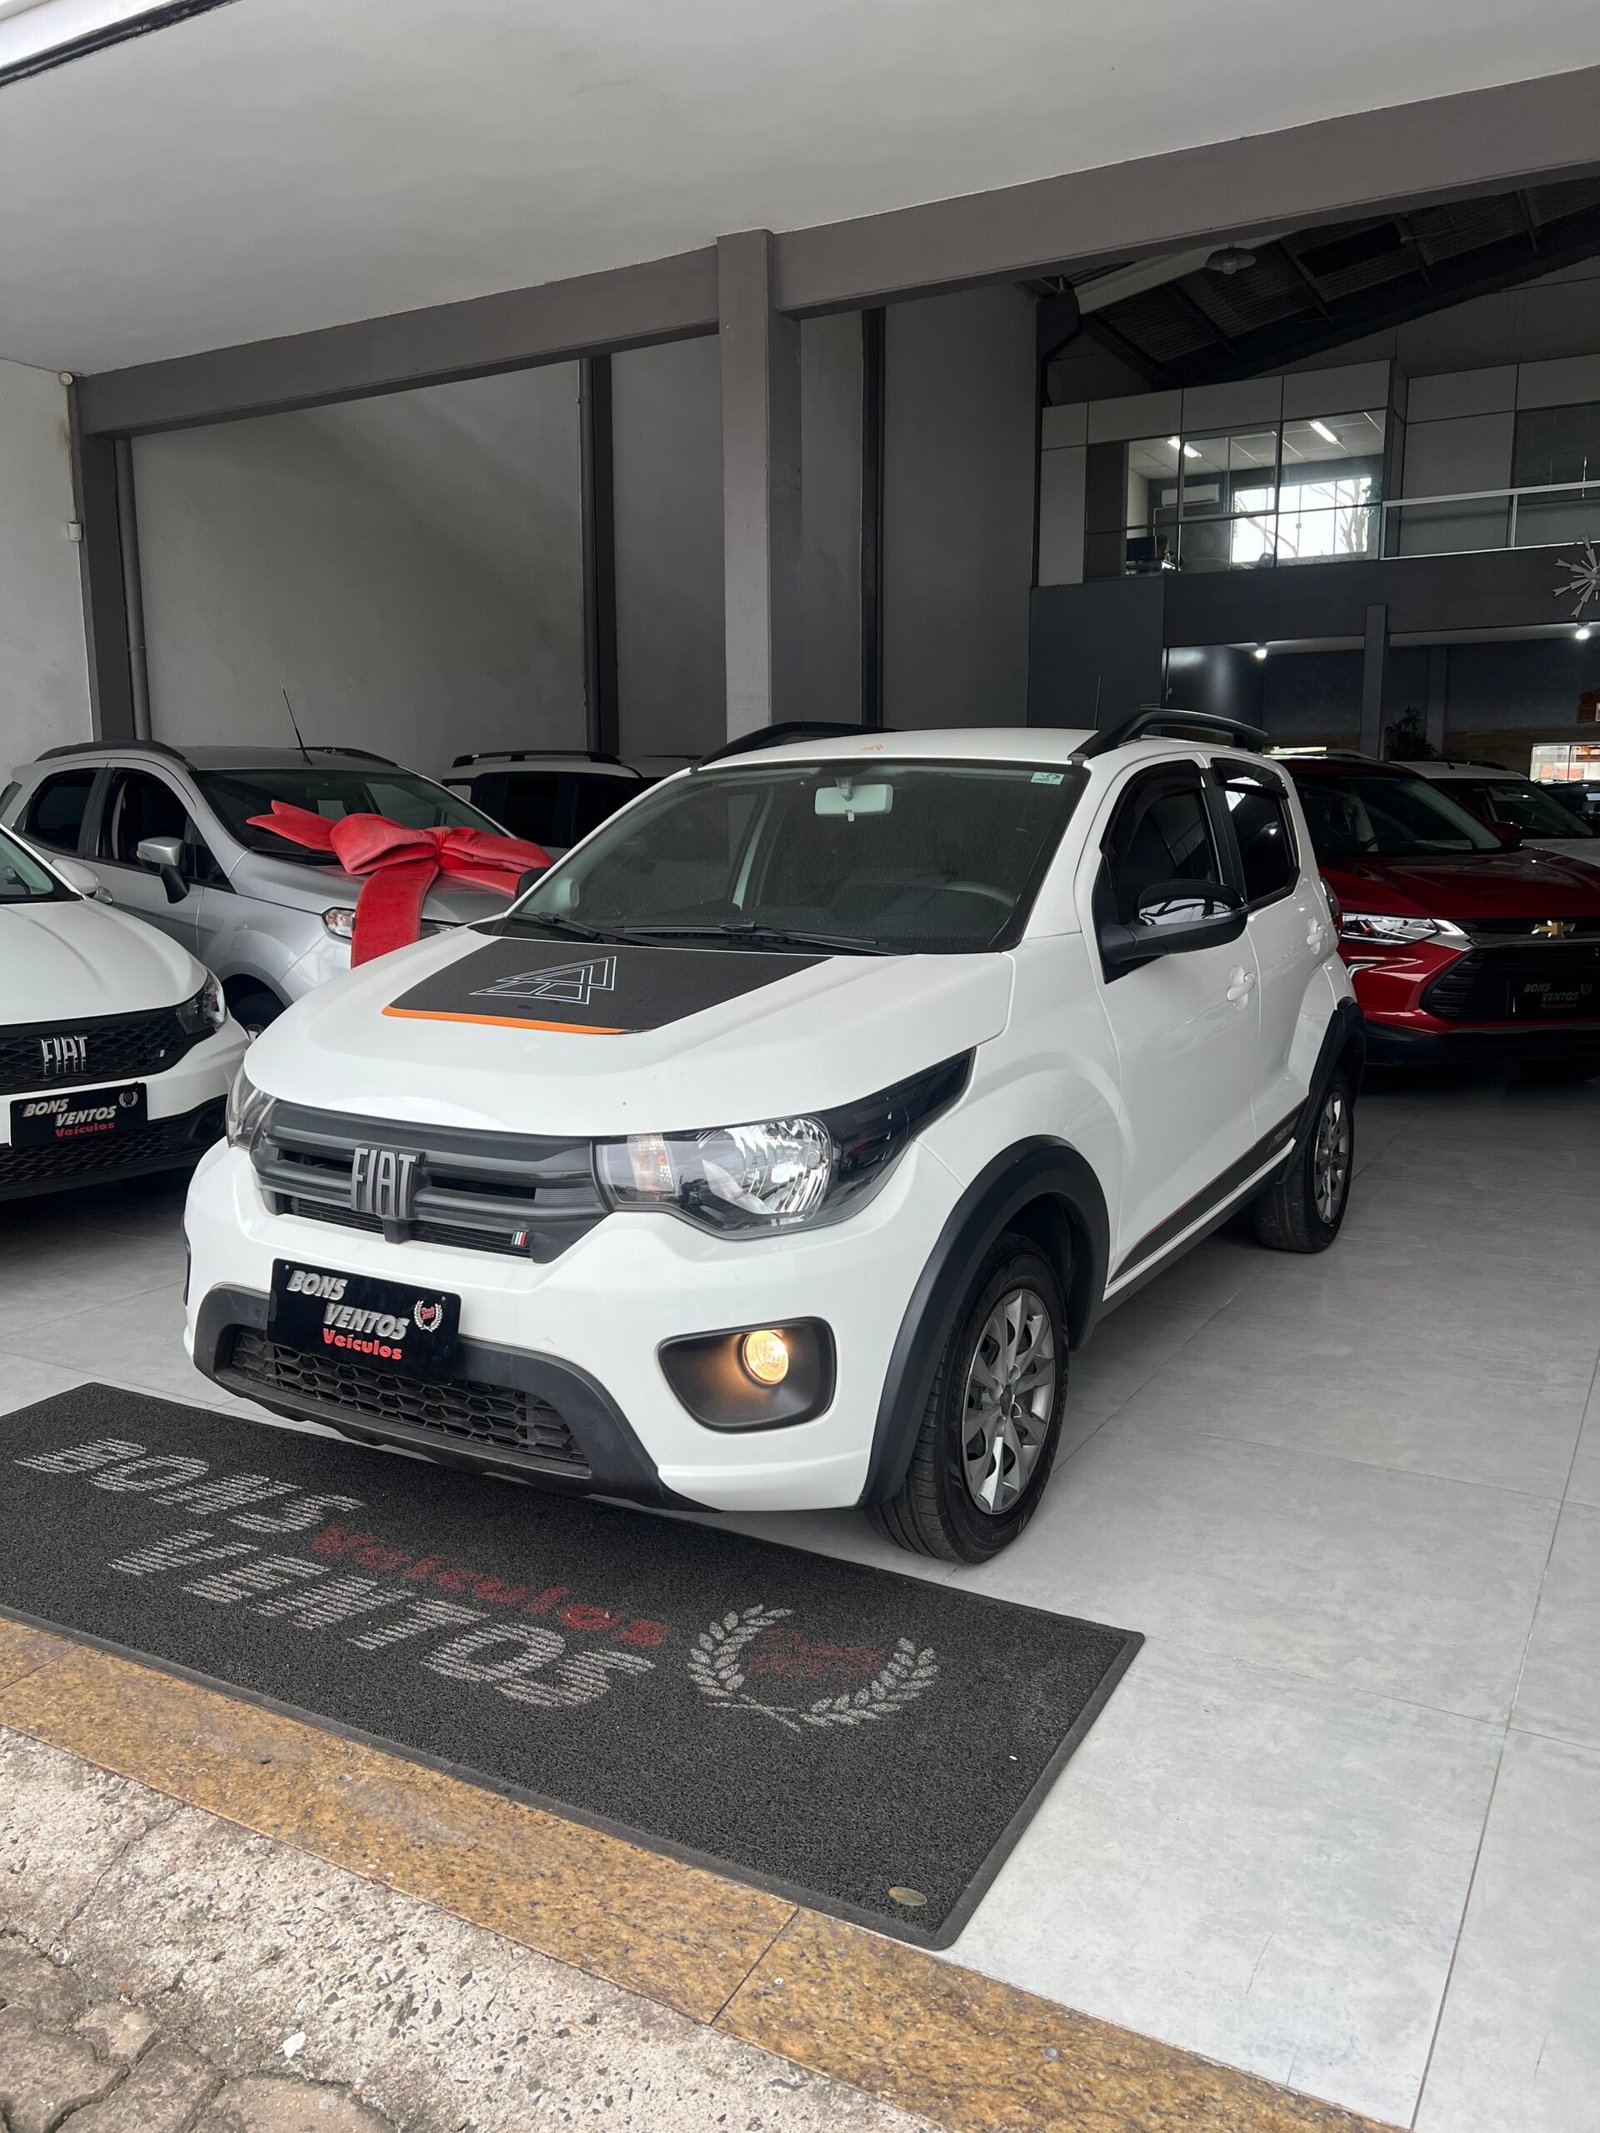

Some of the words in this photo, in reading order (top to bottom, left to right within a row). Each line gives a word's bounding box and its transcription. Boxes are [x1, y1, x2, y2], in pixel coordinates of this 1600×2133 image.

[1523, 983, 1550, 993] BONS
[1541, 991, 1579, 1001] VENTOS
[40, 1034, 88, 1077] FIAT
[23, 1098, 70, 1118] BONS
[54, 1105, 117, 1127] VENTOS
[352, 1146, 420, 1220] FIAT
[286, 1270, 349, 1301] BONS
[323, 1302, 411, 1341] VENTOS
[321, 1327, 404, 1361] Veículos
[13, 1437, 366, 1534] BONS
[106, 1528, 656, 1708] VENTOS
